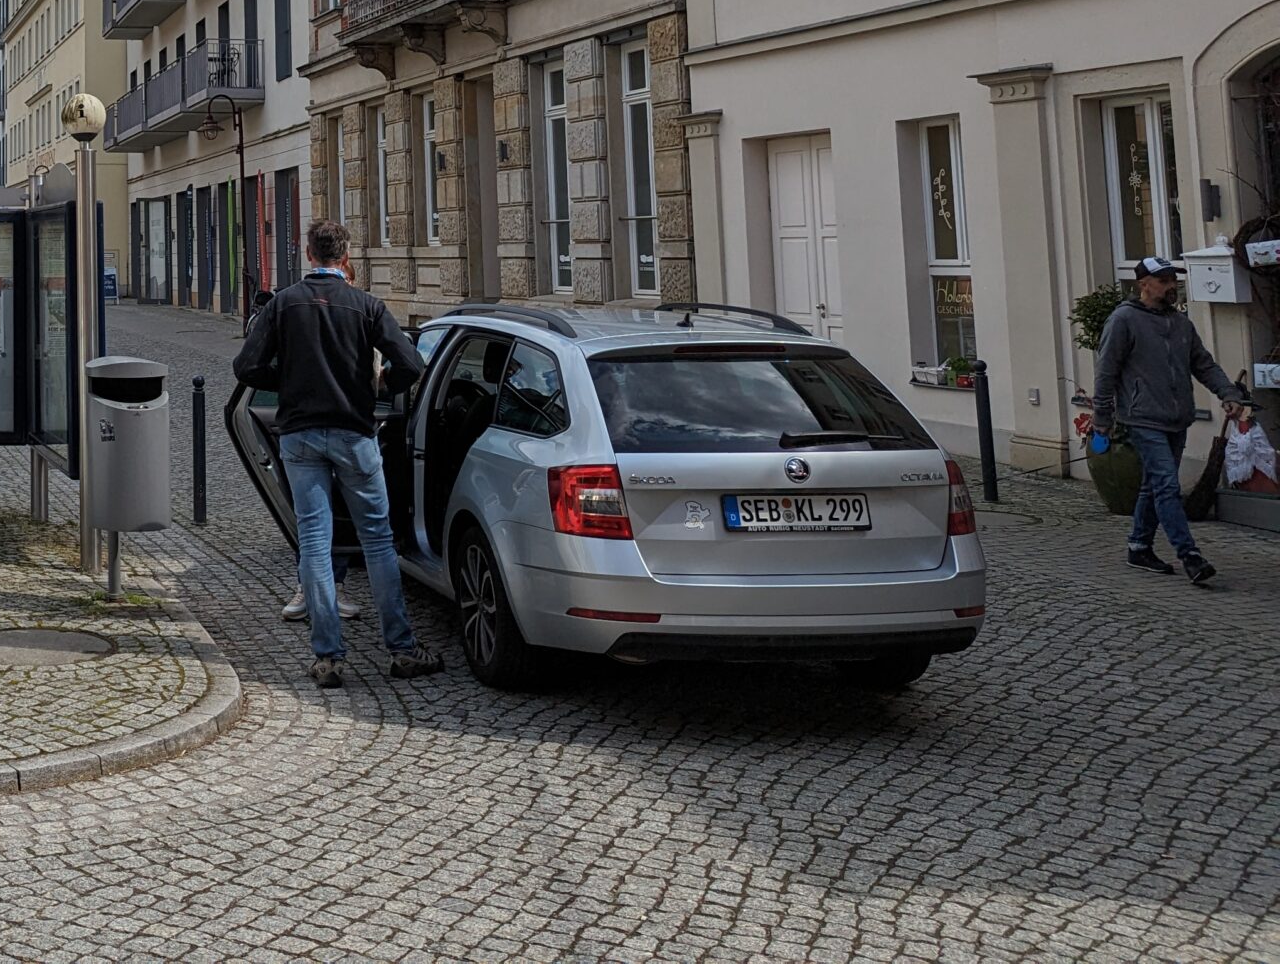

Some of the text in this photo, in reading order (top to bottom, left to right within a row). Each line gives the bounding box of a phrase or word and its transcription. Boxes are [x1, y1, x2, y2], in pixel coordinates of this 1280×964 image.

[740, 499, 781, 523] SEB
[794, 498, 822, 522] KL
[826, 498, 864, 522] 299
